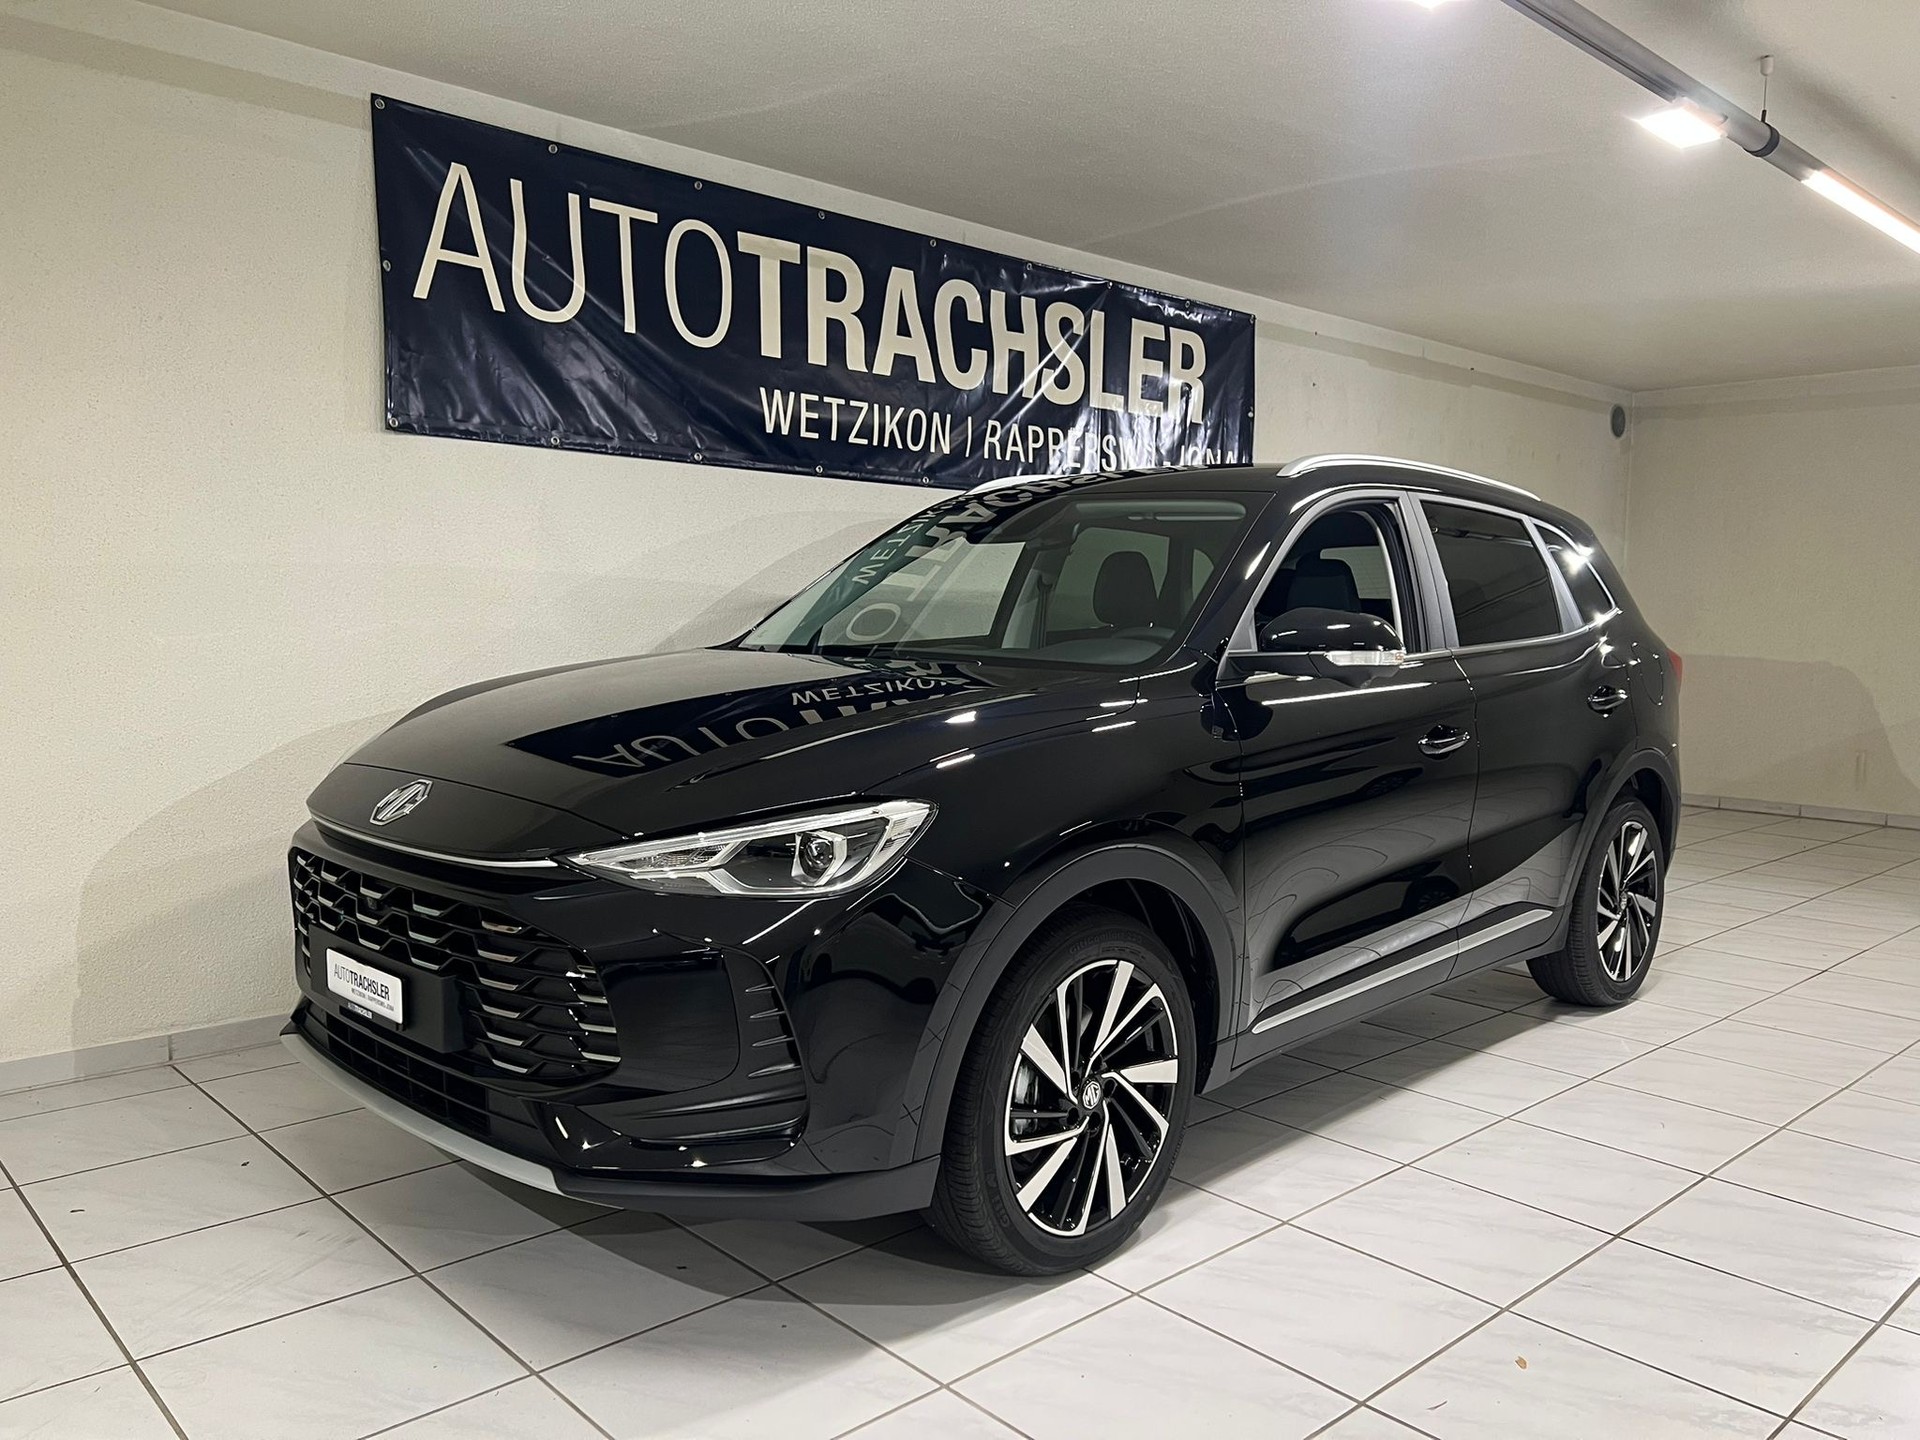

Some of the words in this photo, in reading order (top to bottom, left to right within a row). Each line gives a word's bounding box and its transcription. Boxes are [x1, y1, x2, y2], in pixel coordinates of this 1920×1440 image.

[413, 162, 1207, 425] AUTOTRACHSLER
[759, 386, 952, 456] WETZIKON
[334, 963, 391, 1001] AUTOTRACHSLER
